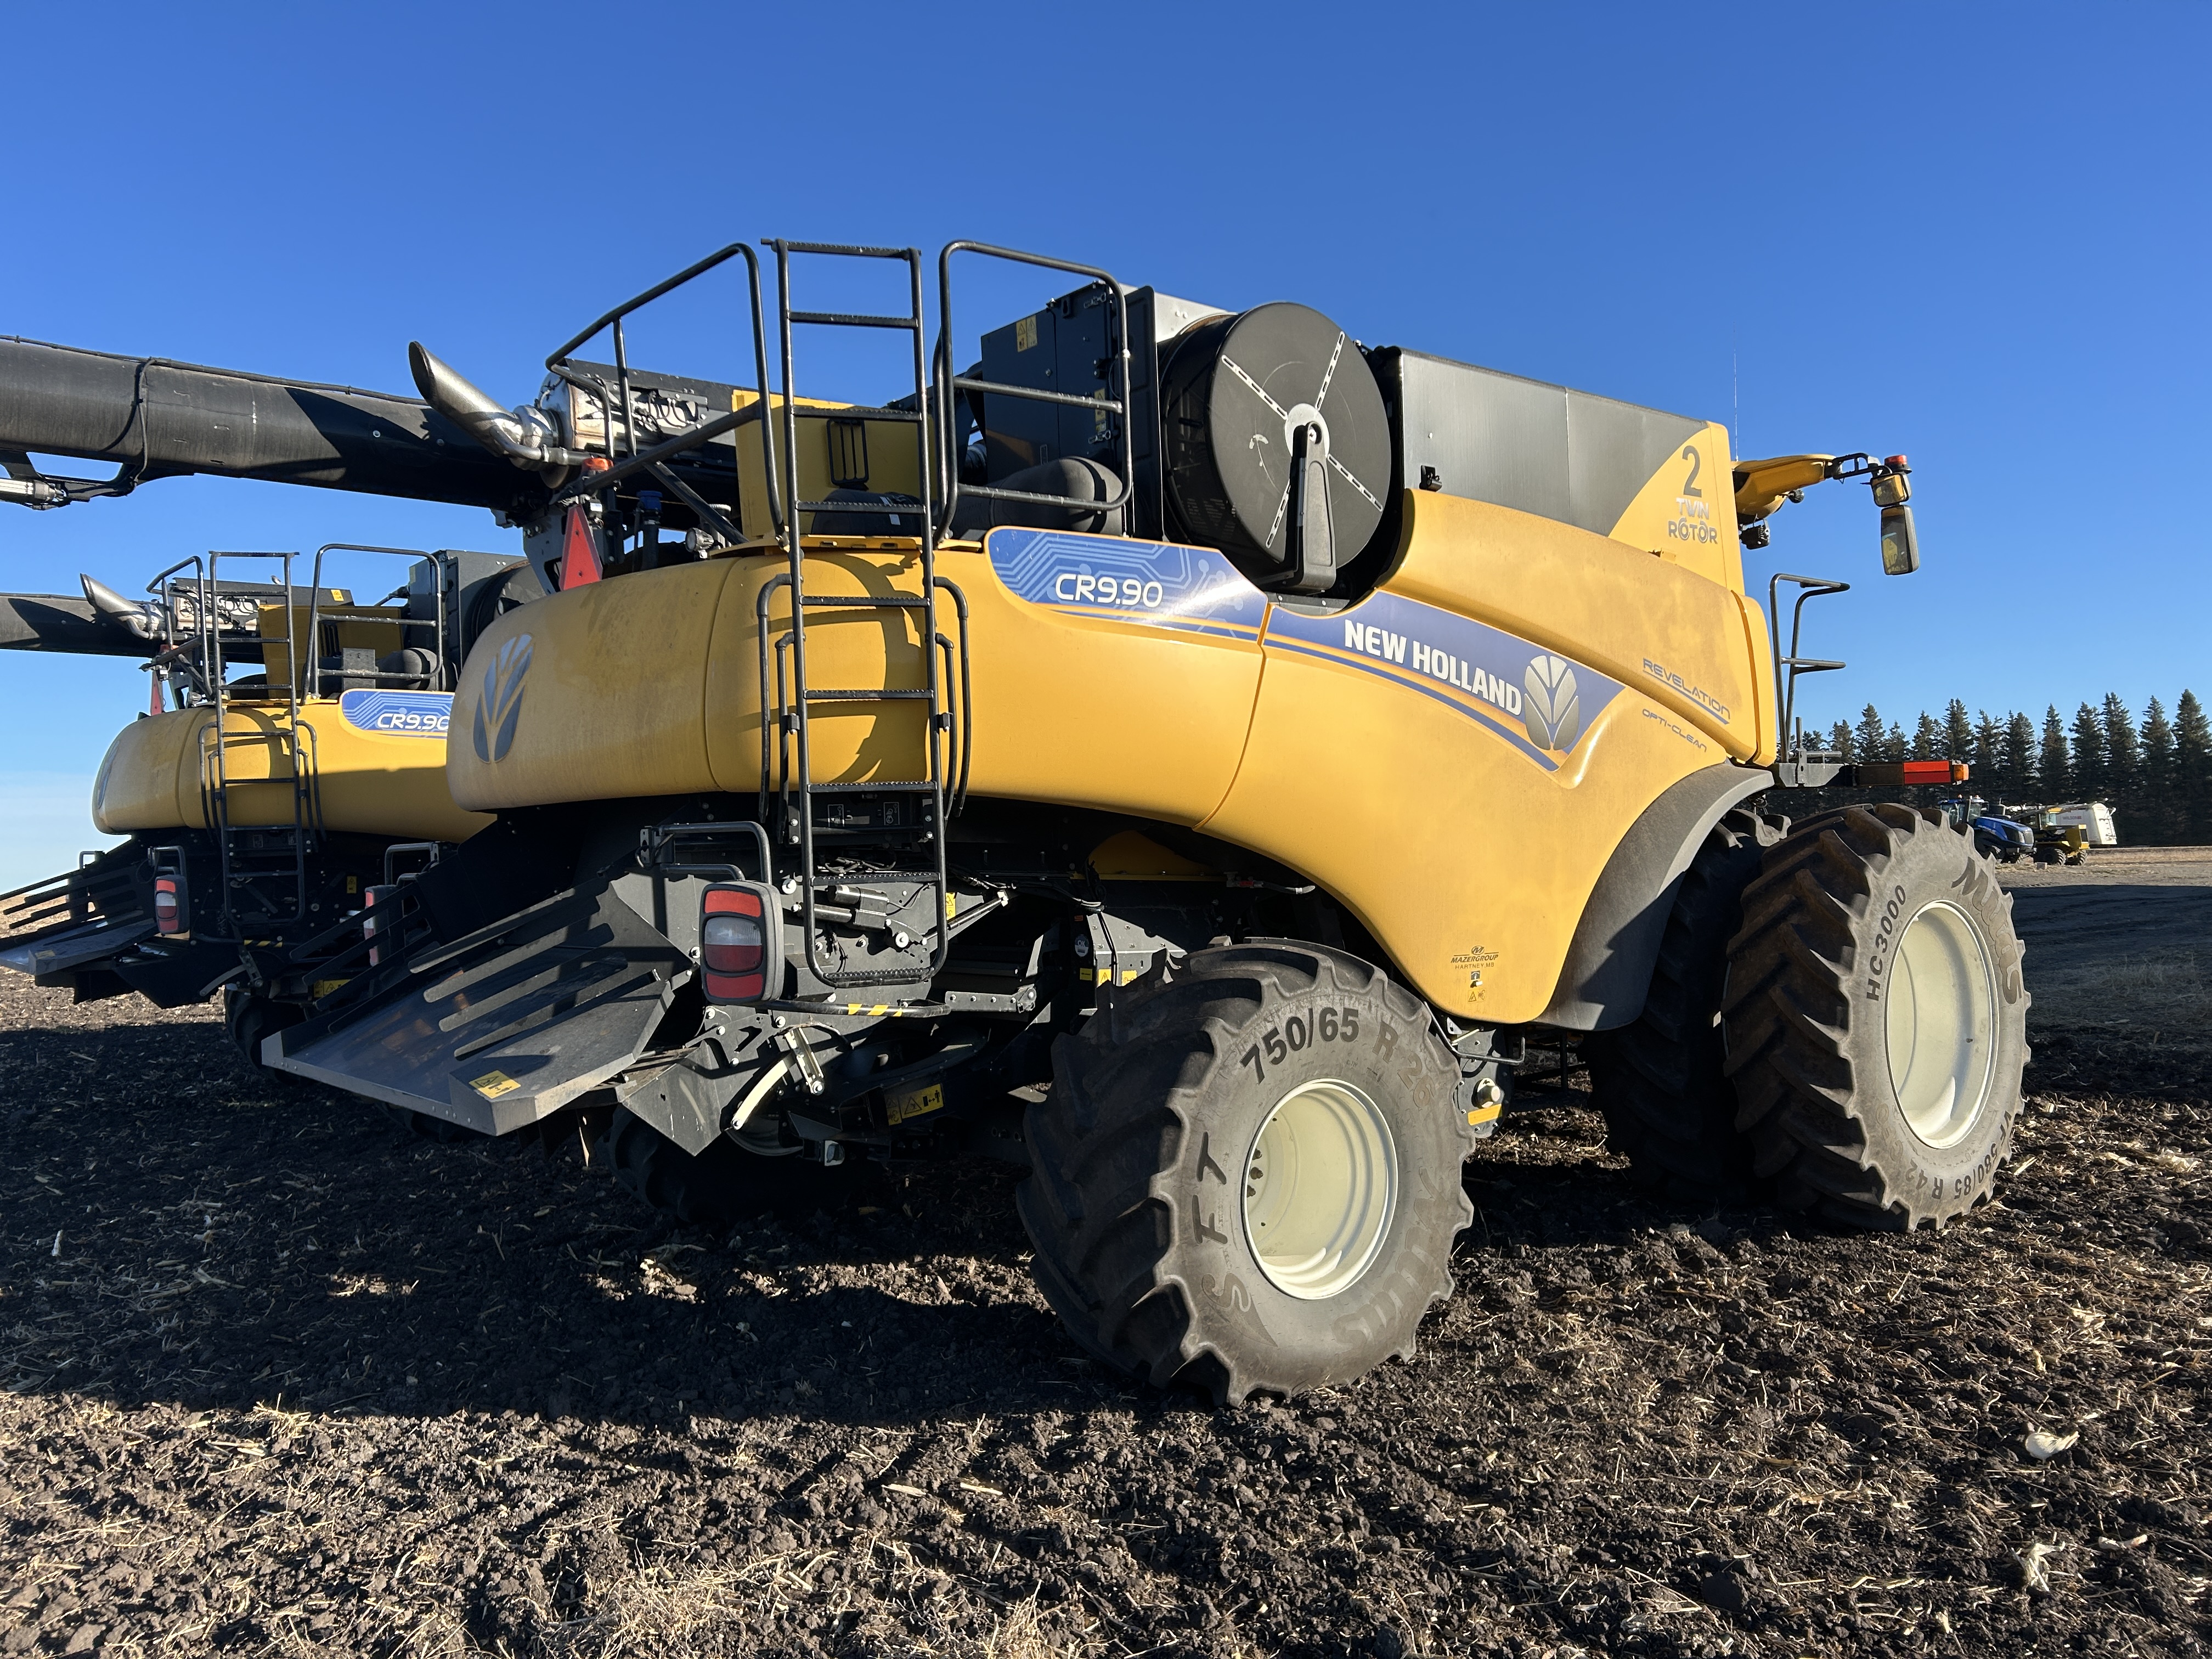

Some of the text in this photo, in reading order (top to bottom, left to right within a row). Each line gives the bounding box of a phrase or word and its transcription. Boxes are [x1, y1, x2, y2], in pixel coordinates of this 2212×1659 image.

[1682, 445, 1702, 498] 2
[1668, 516, 1718, 544] ROTOR
[1676, 497, 1709, 520] TWIN
[1055, 573, 1164, 608] CR9.90
[1345, 619, 1522, 716] NEW HOLLAND
[1643, 657, 1731, 720] REVELATION
[1642, 708, 1707, 753] OPTI-CLEAN
[1450, 954, 1499, 963] MAZERGROUP
[1866, 884, 1906, 1002] HC3000
[1239, 1007, 1359, 1086] 750/65
[1953, 1143, 1998, 1200] 580/85
